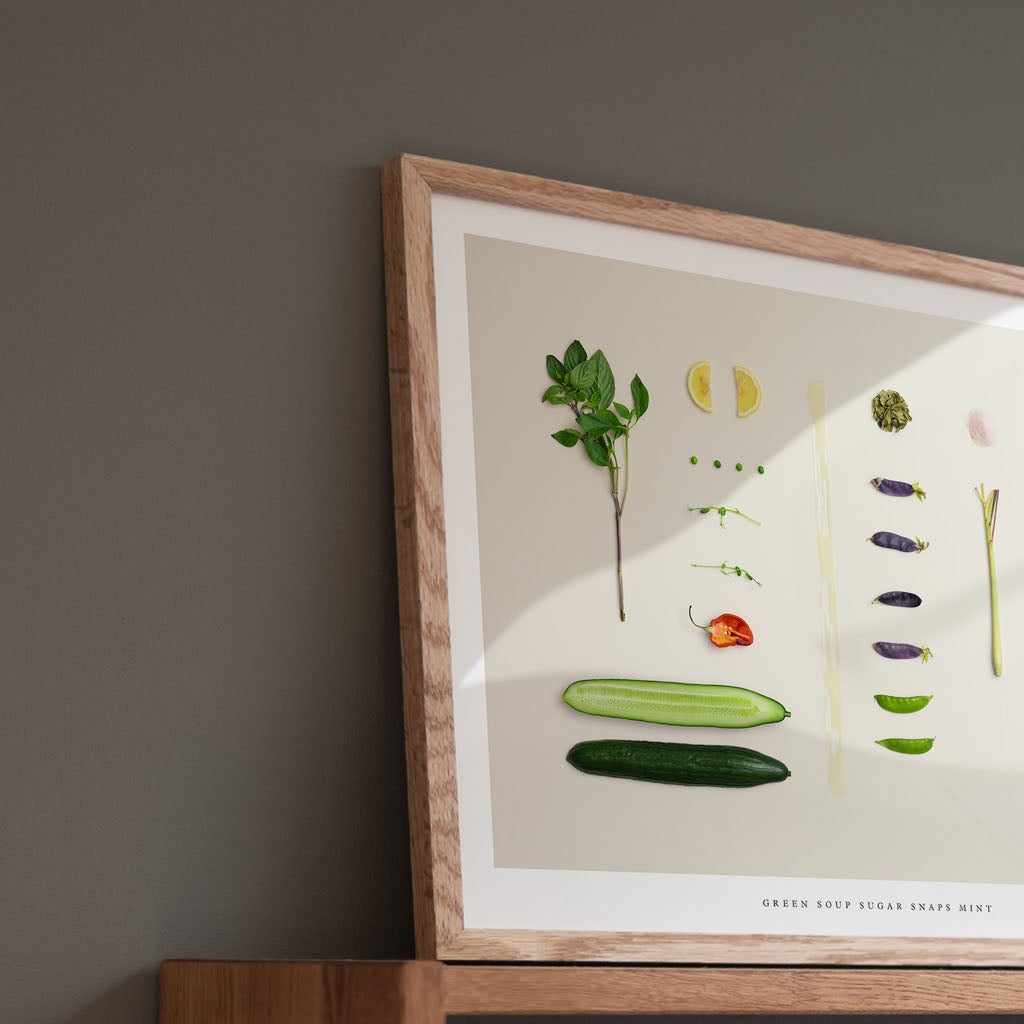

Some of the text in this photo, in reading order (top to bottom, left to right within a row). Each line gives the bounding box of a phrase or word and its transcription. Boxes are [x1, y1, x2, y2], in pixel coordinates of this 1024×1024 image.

[762, 898, 993, 913] GREEN SOUP SUGAR SNAPS MINT
